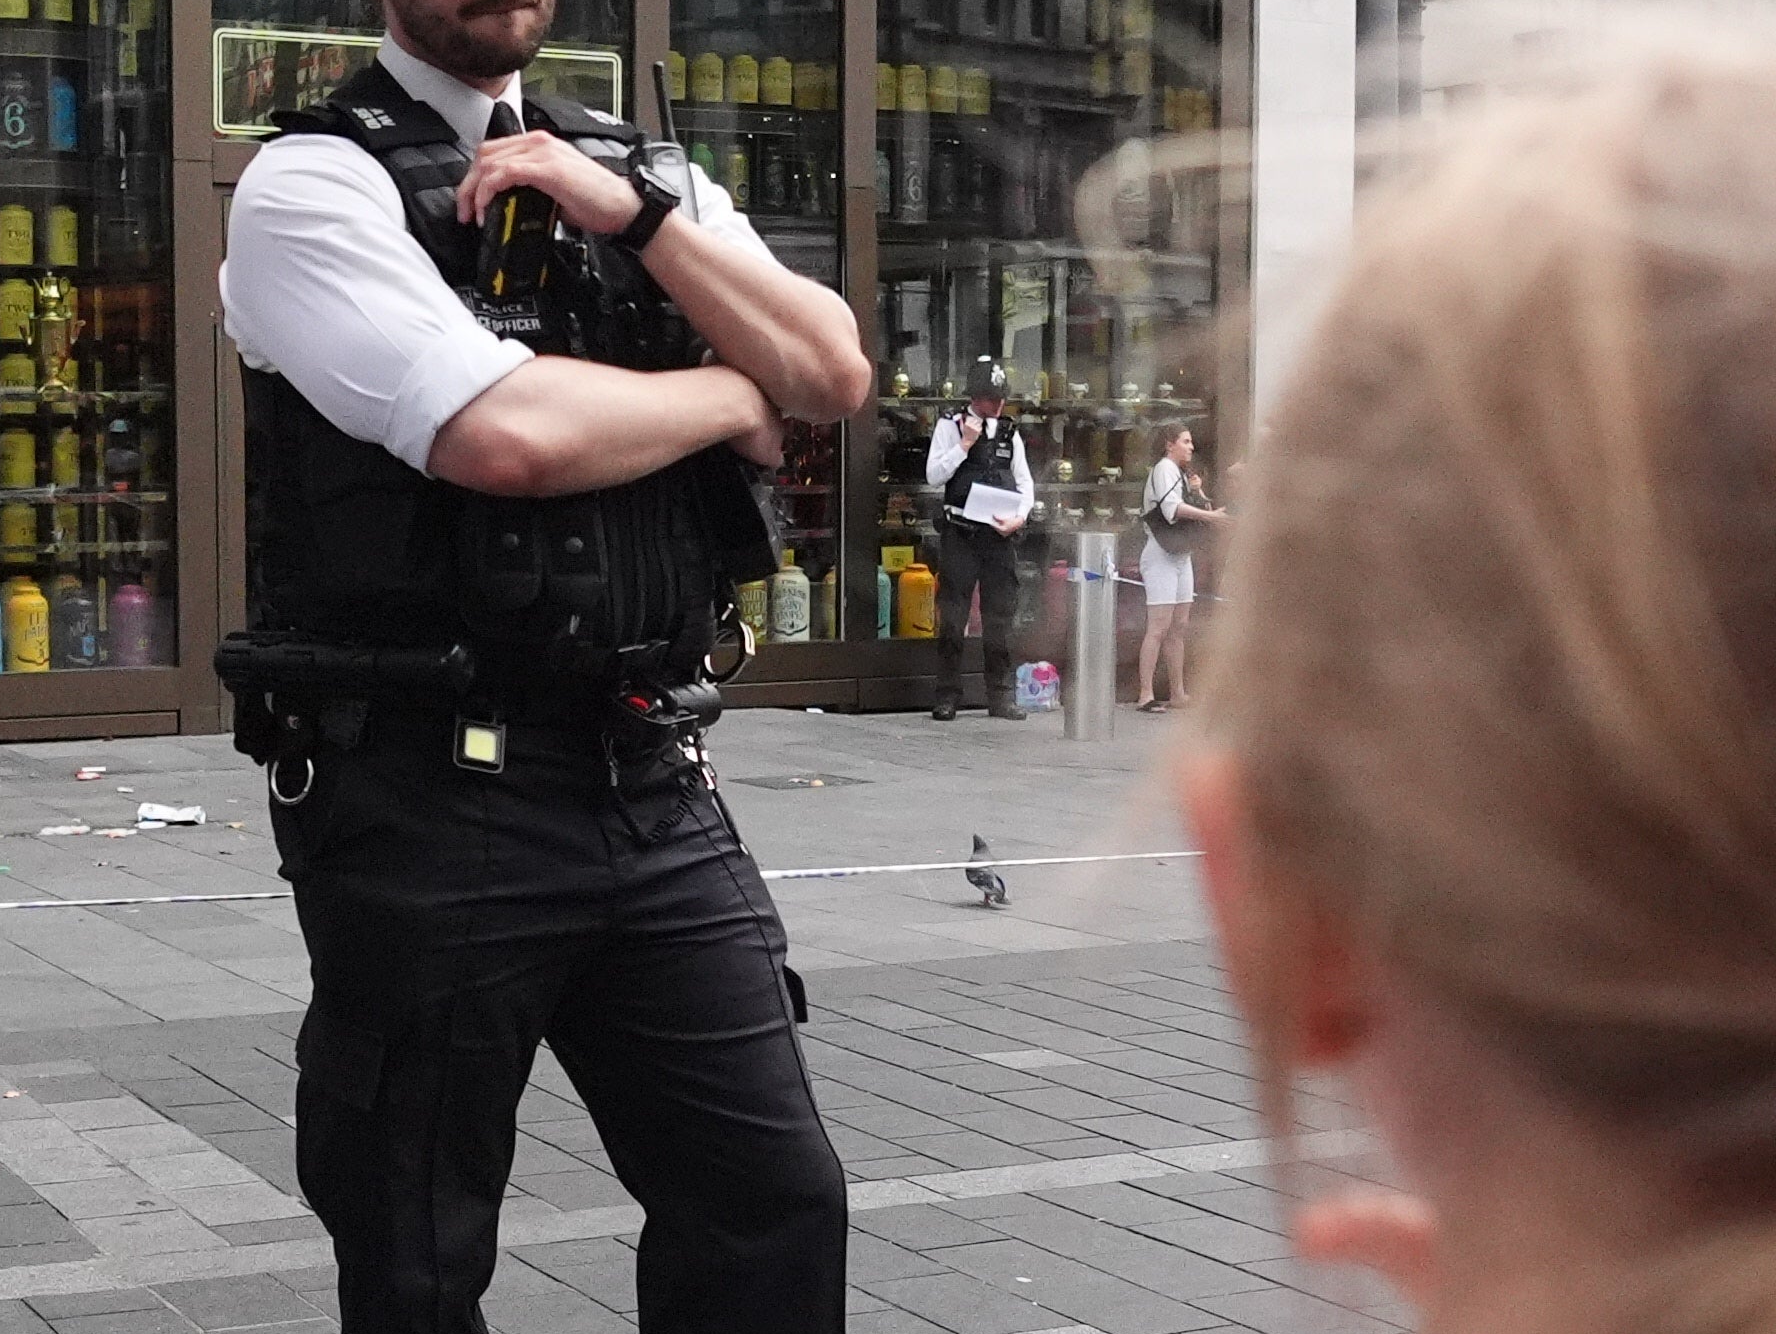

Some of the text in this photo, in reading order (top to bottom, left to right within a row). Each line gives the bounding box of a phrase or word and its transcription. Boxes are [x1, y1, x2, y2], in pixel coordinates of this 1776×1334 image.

[4, 102, 25, 136] 6
[908, 175, 923, 202] 6
[491, 318, 541, 333] OFFICER
